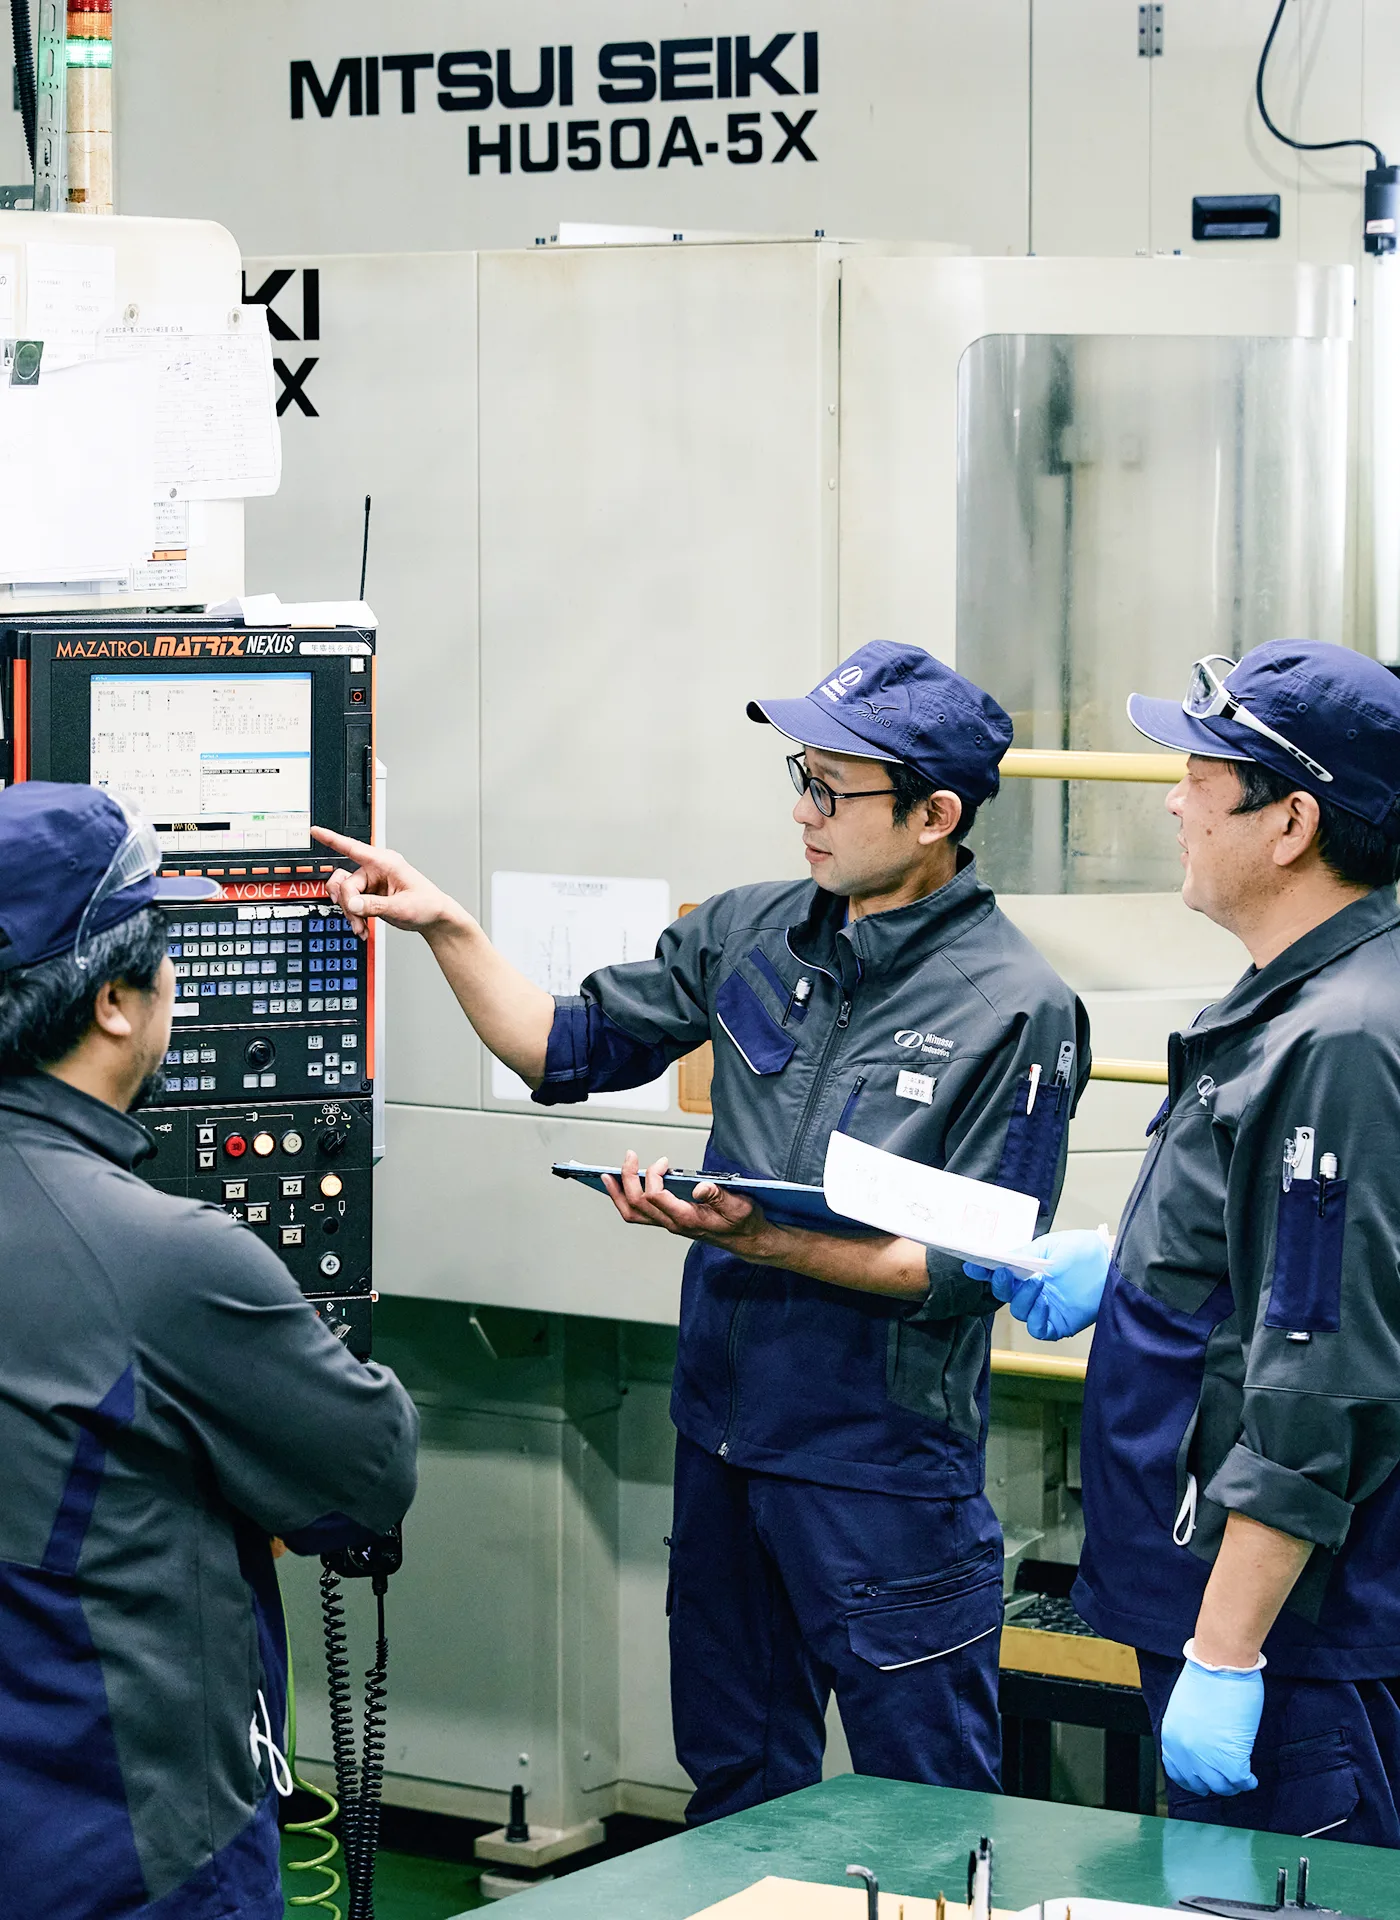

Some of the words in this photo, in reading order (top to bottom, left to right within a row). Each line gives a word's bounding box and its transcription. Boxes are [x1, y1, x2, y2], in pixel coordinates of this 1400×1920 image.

[290, 45, 574, 120] MITSUI
[598, 31, 819, 104] SEIKI
[468, 109, 818, 176] HU50A-5X
[56, 640, 151, 658] MAZATROL
[152, 635, 247, 657] MATRIX
[246, 633, 296, 656] NEXUS
[234, 883, 281, 899] VOICE
[287, 881, 330, 897] ADVI
[312, 921, 318, 930] 7
[329, 920, 335, 929] 8
[222, 944, 229, 952] O
[312, 940, 318, 949] 4
[329, 940, 335, 949] 5
[346, 940, 352, 949] 6
[170, 946, 176, 954] Y
[329, 960, 335, 968] 2
[346, 959, 352, 968] 3
[328, 980, 335, 988] 0
[229, 1187, 241, 1195] -Y
[286, 1184, 298, 1192] +Z
[250, 1210, 263, 1219] -X
[286, 1232, 298, 1241] -Z
